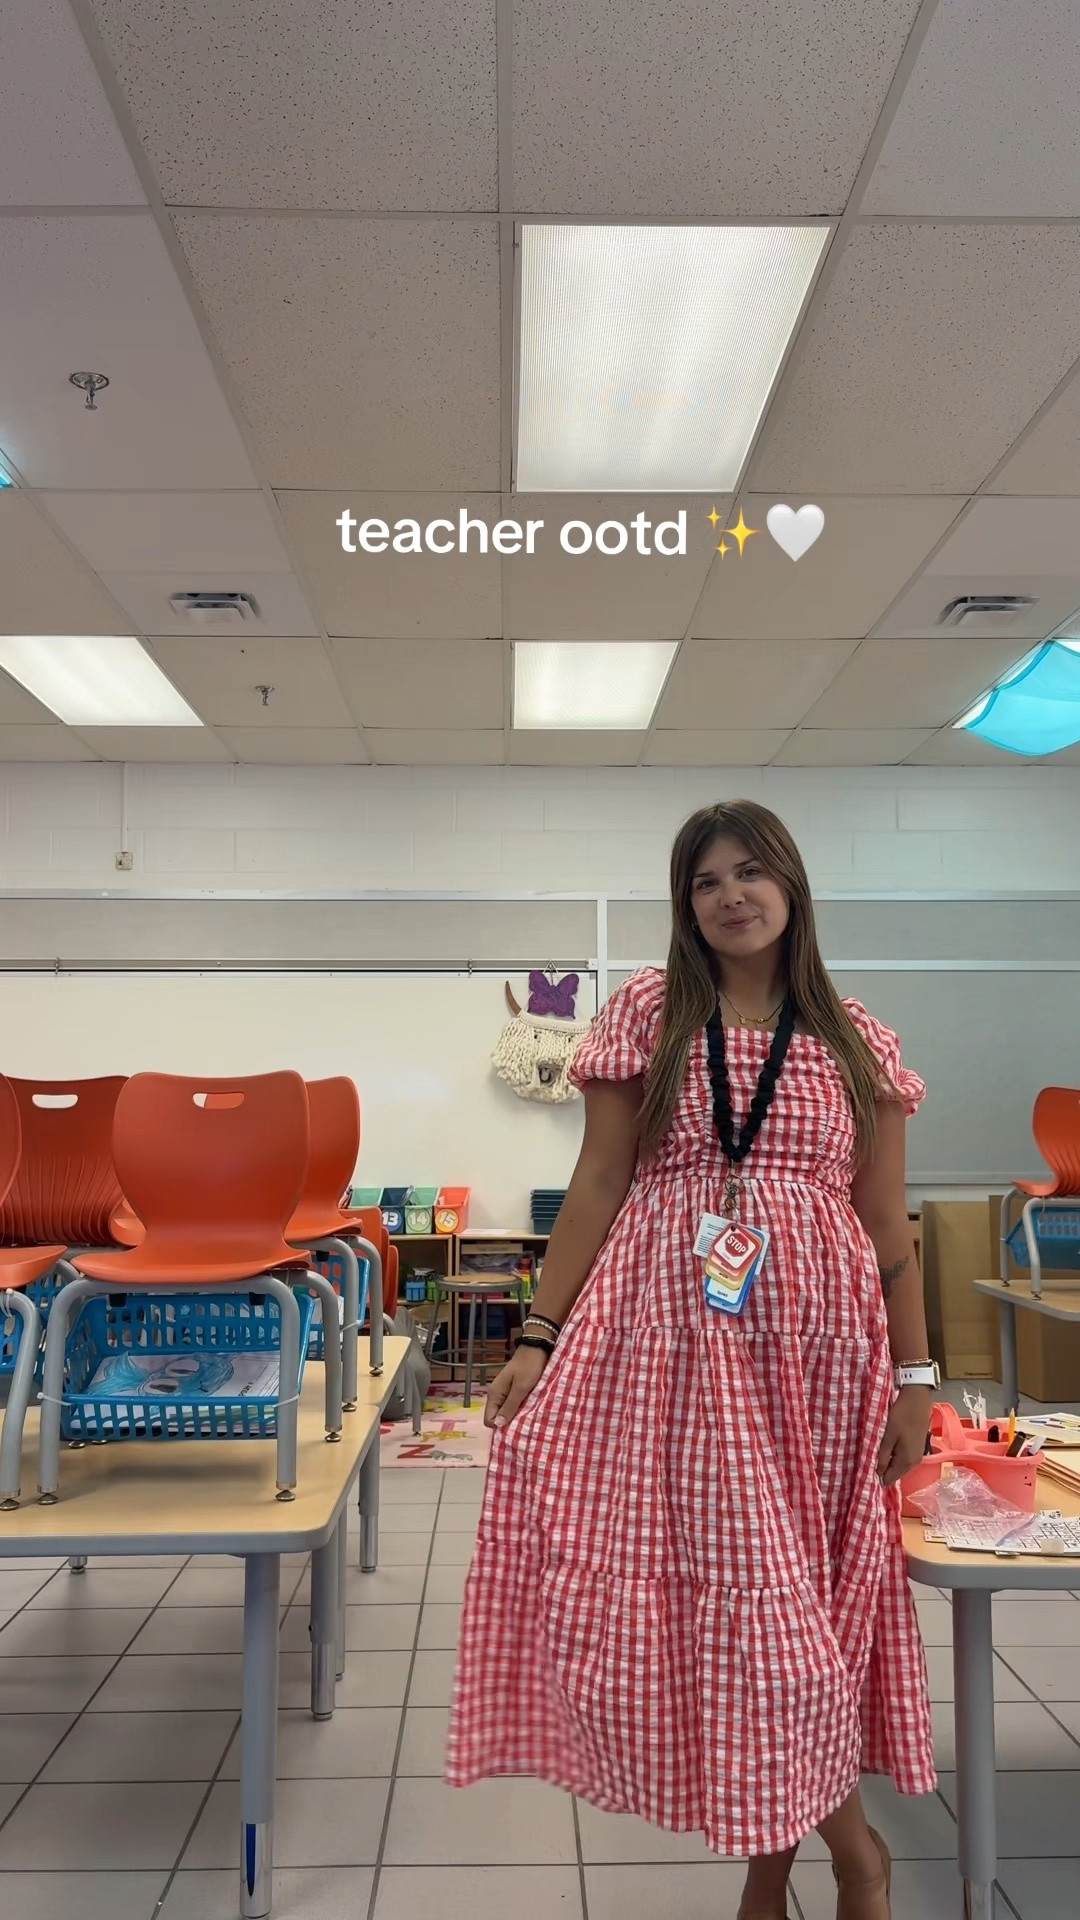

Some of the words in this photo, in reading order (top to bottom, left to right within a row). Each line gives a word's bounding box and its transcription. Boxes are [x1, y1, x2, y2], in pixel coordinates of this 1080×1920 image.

[382, 1211, 399, 1226] 13
[410, 1212, 428, 1226] 14
[440, 1211, 456, 1228] 15
[727, 1236, 747, 1254] STOP
[397, 1445, 435, 1459] Z
